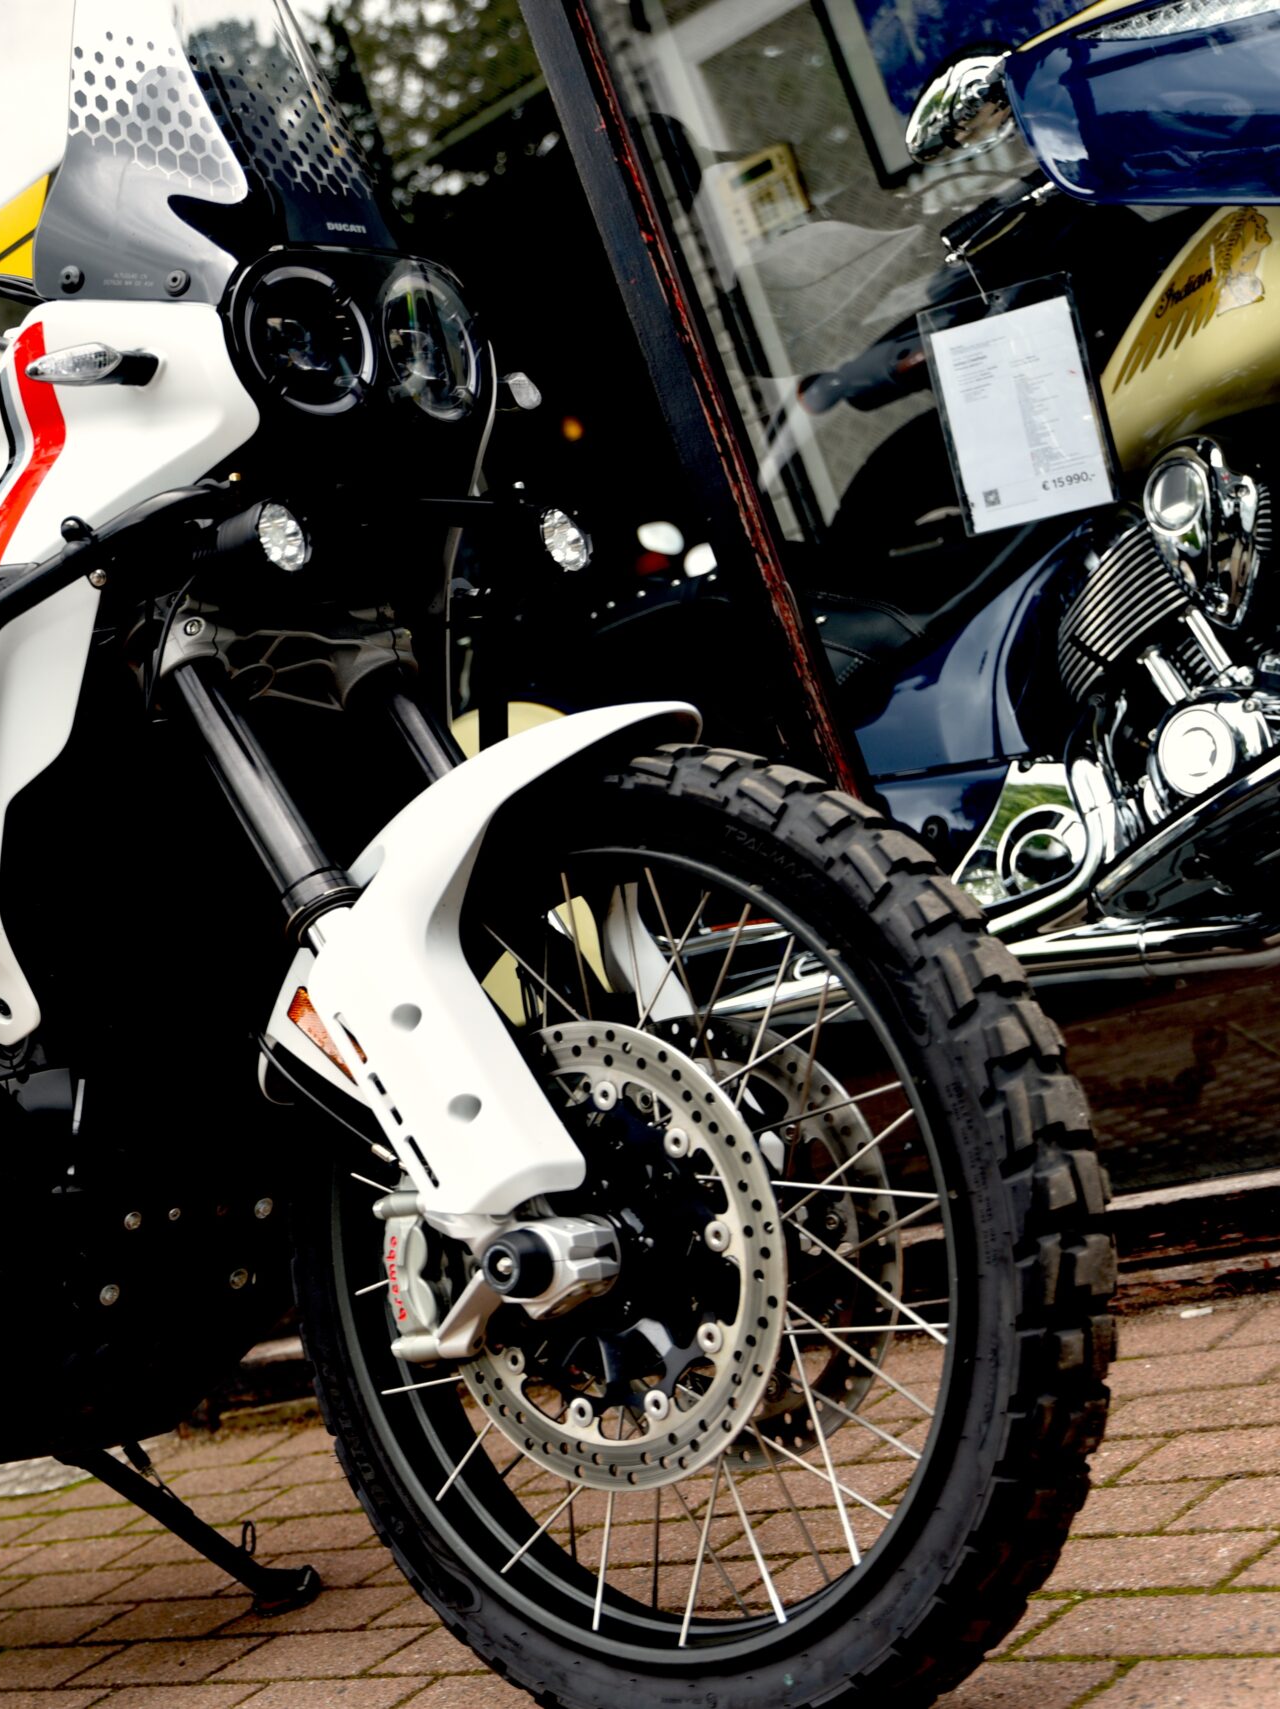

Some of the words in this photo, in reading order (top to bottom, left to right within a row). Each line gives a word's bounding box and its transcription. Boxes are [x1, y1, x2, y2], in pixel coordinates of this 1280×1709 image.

[325, 220, 368, 234] DUCATI
[1154, 266, 1214, 319] Indian
[385, 1235, 408, 1322] brembo
